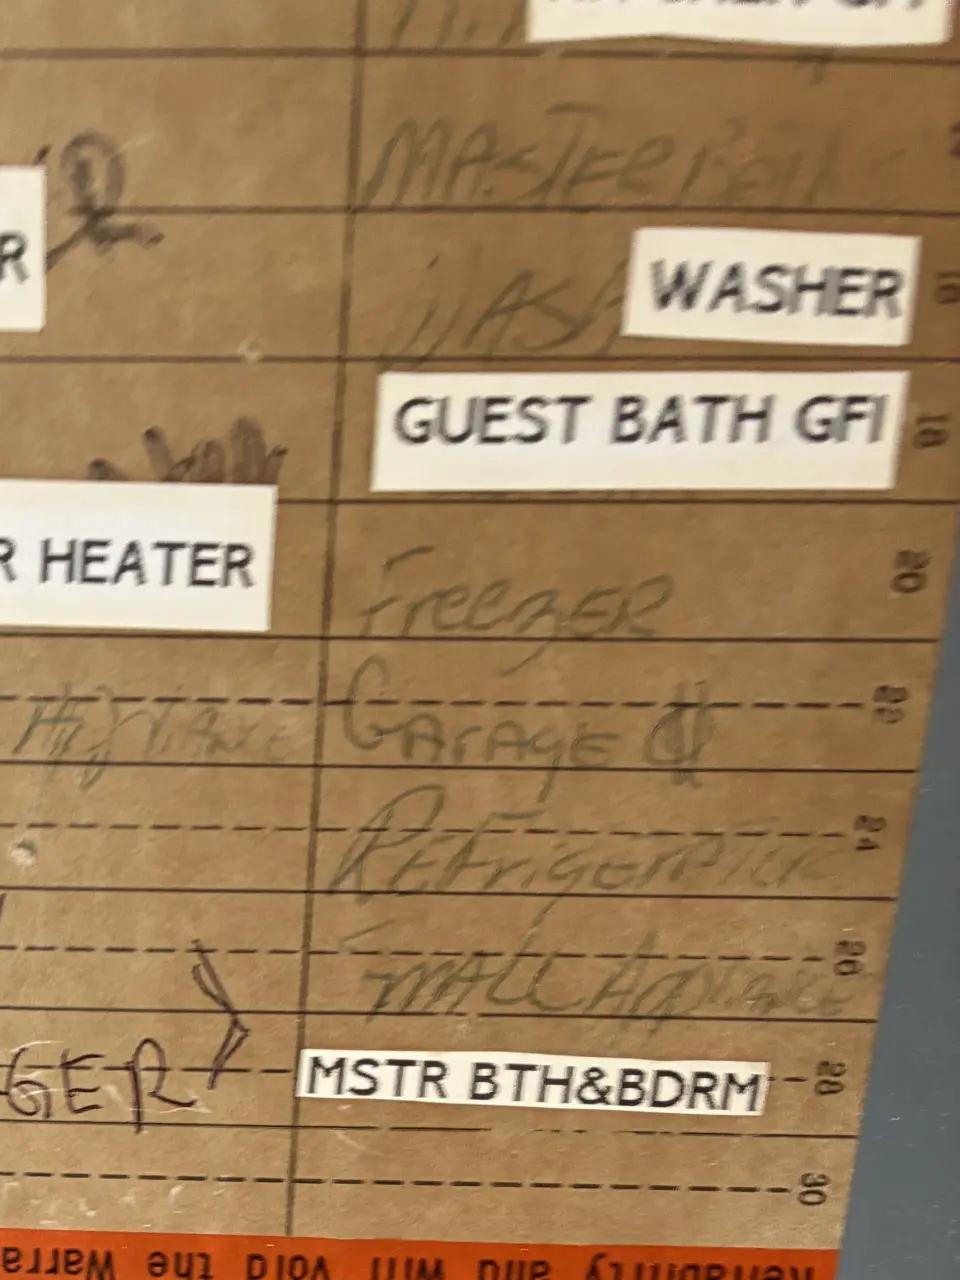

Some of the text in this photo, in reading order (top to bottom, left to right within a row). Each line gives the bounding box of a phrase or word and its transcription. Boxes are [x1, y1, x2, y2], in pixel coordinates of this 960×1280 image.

[651, 258, 904, 319] WASHER
[394, 394, 889, 446] GUEST BATH GFI
[912, 412, 950, 450] 18
[39, 538, 255, 588] HEATER
[892, 550, 930, 595] 20
[306, 1056, 764, 1113] MSTR BTH&BDRM
[814, 1060, 847, 1097] 28
[798, 1172, 831, 1207] 30
